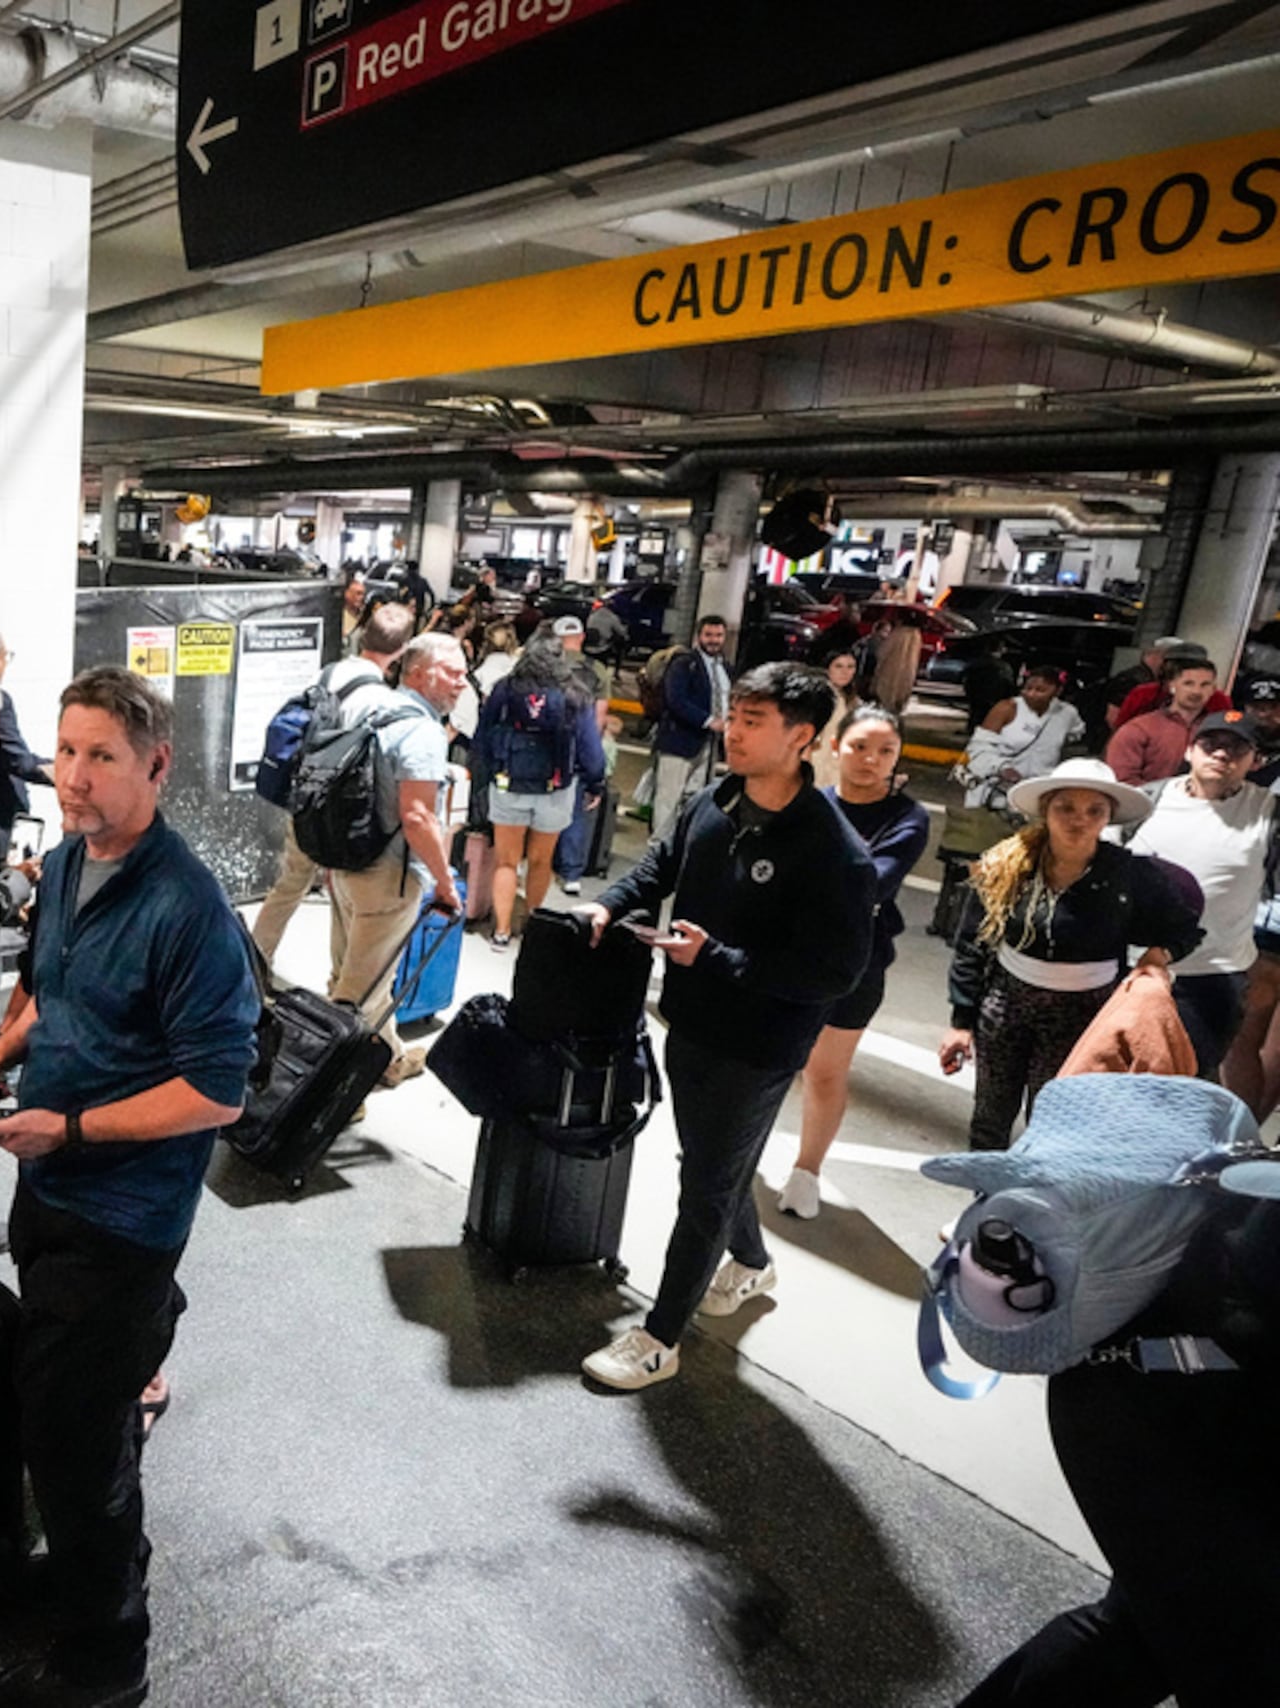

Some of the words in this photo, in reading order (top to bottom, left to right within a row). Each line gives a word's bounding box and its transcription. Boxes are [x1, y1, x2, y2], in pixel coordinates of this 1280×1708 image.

[271, 15, 284, 46] 1
[356, 18, 427, 90] Red
[633, 220, 960, 327] CAUTION:
[1006, 157, 1280, 275] CROS
[181, 627, 230, 644] CAUTION
